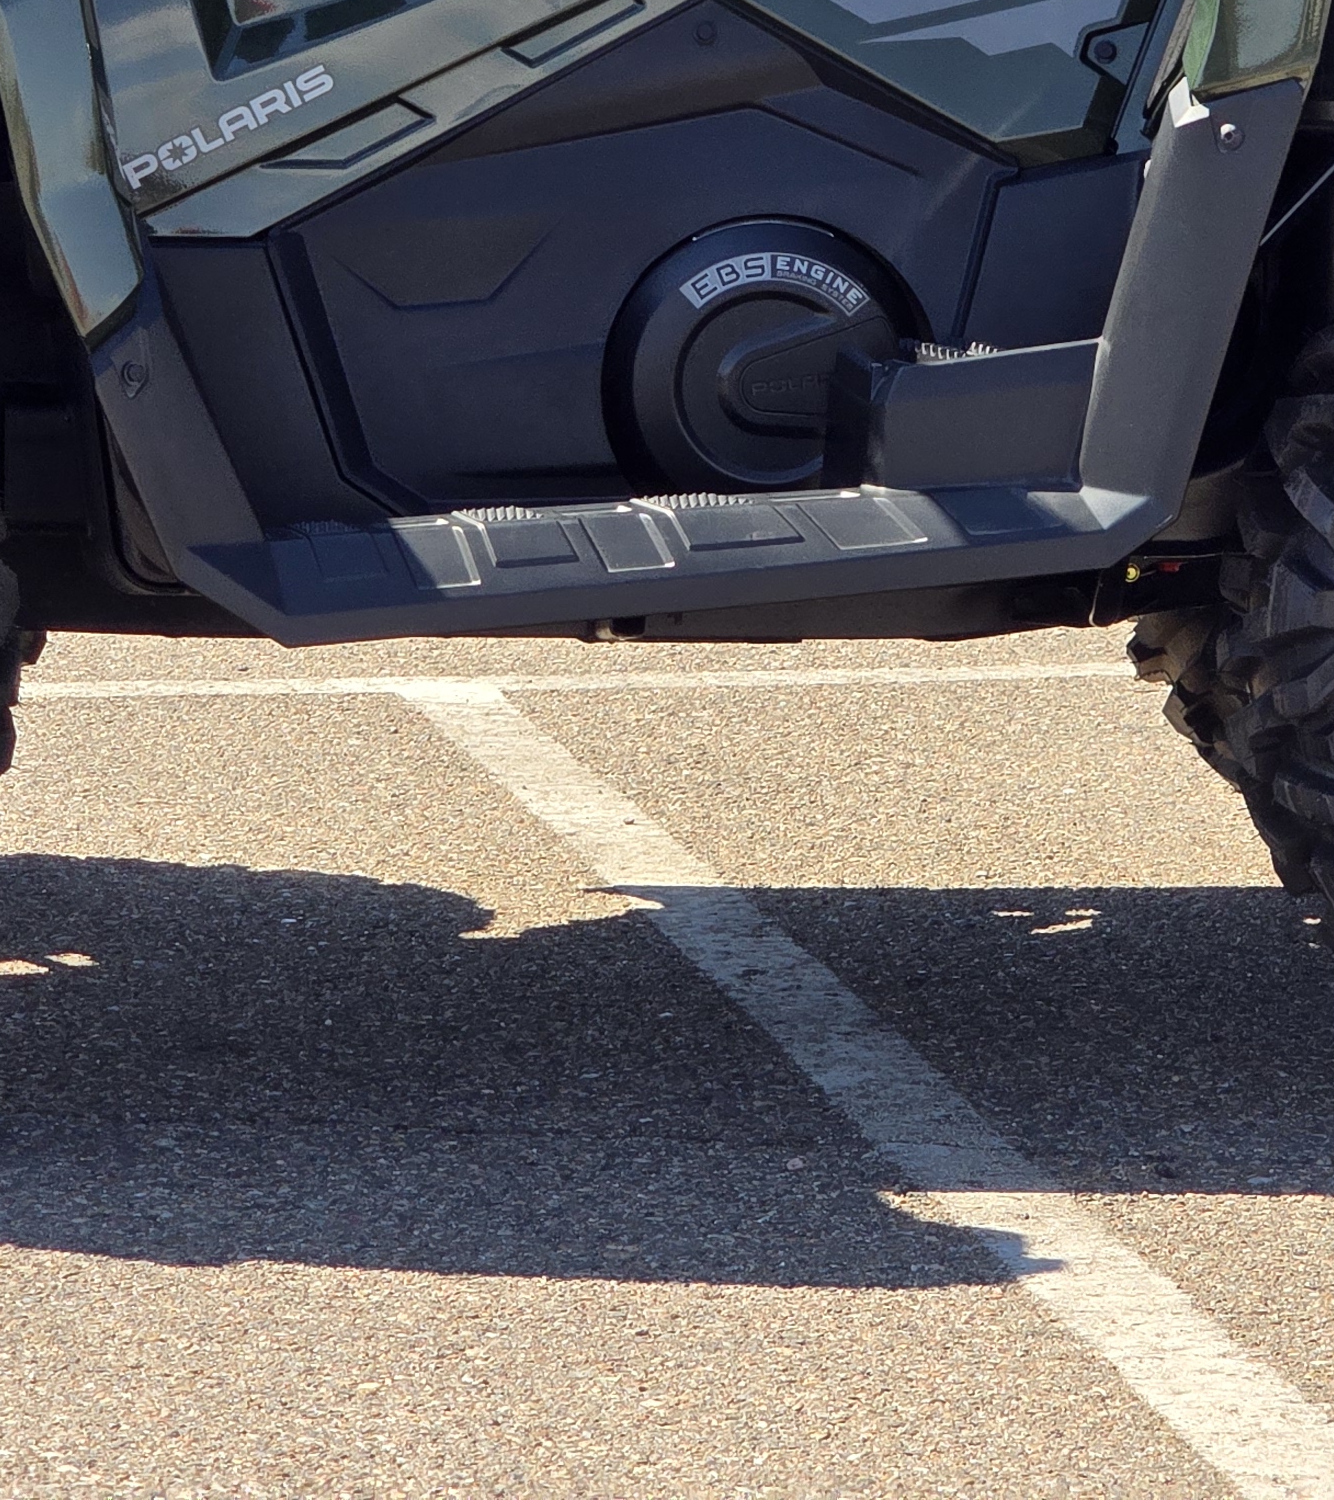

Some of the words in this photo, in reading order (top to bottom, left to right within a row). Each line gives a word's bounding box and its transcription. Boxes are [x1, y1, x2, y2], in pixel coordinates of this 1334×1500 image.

[122, 64, 334, 190] POLARIS
[690, 256, 767, 301] EBS
[776, 255, 863, 305] ENGINE
[776, 269, 817, 286] BRAKING
